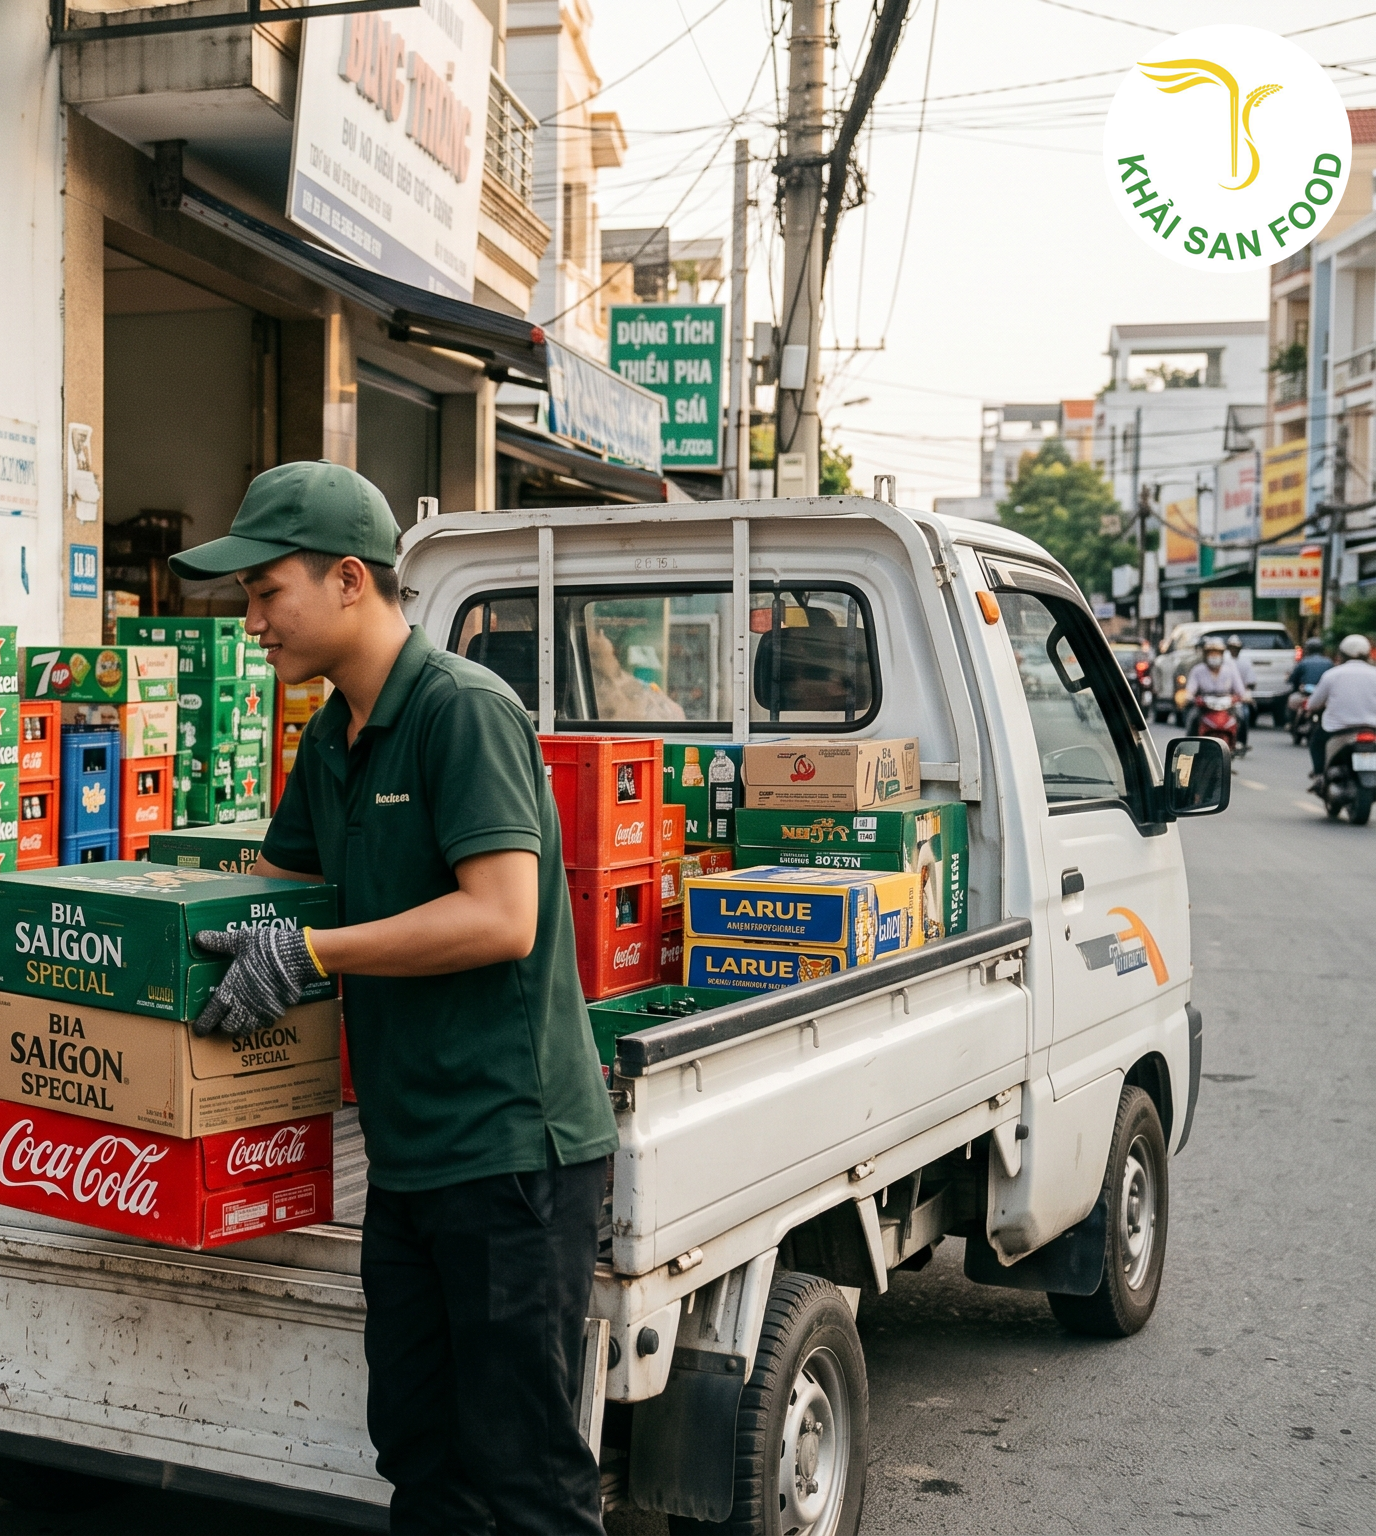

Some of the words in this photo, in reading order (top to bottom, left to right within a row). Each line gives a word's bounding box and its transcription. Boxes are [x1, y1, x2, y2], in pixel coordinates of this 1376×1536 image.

[675, 359, 712, 384] PHA
[51, 902, 86, 927] BIA
[250, 903, 277, 918] BIA
[720, 898, 813, 921] LARUE
[15, 923, 123, 968] SAIGON
[26, 961, 114, 997] SPECIAL
[706, 955, 793, 978] LARUE
[49, 1012, 86, 1040] BIA
[232, 1026, 298, 1053] SAIGON
[10, 1031, 123, 1084] SAIGON
[241, 1050, 290, 1067] SPECIAL
[21, 1071, 114, 1112] SPECIAL
[227, 1124, 310, 1176] Coca-Cola
